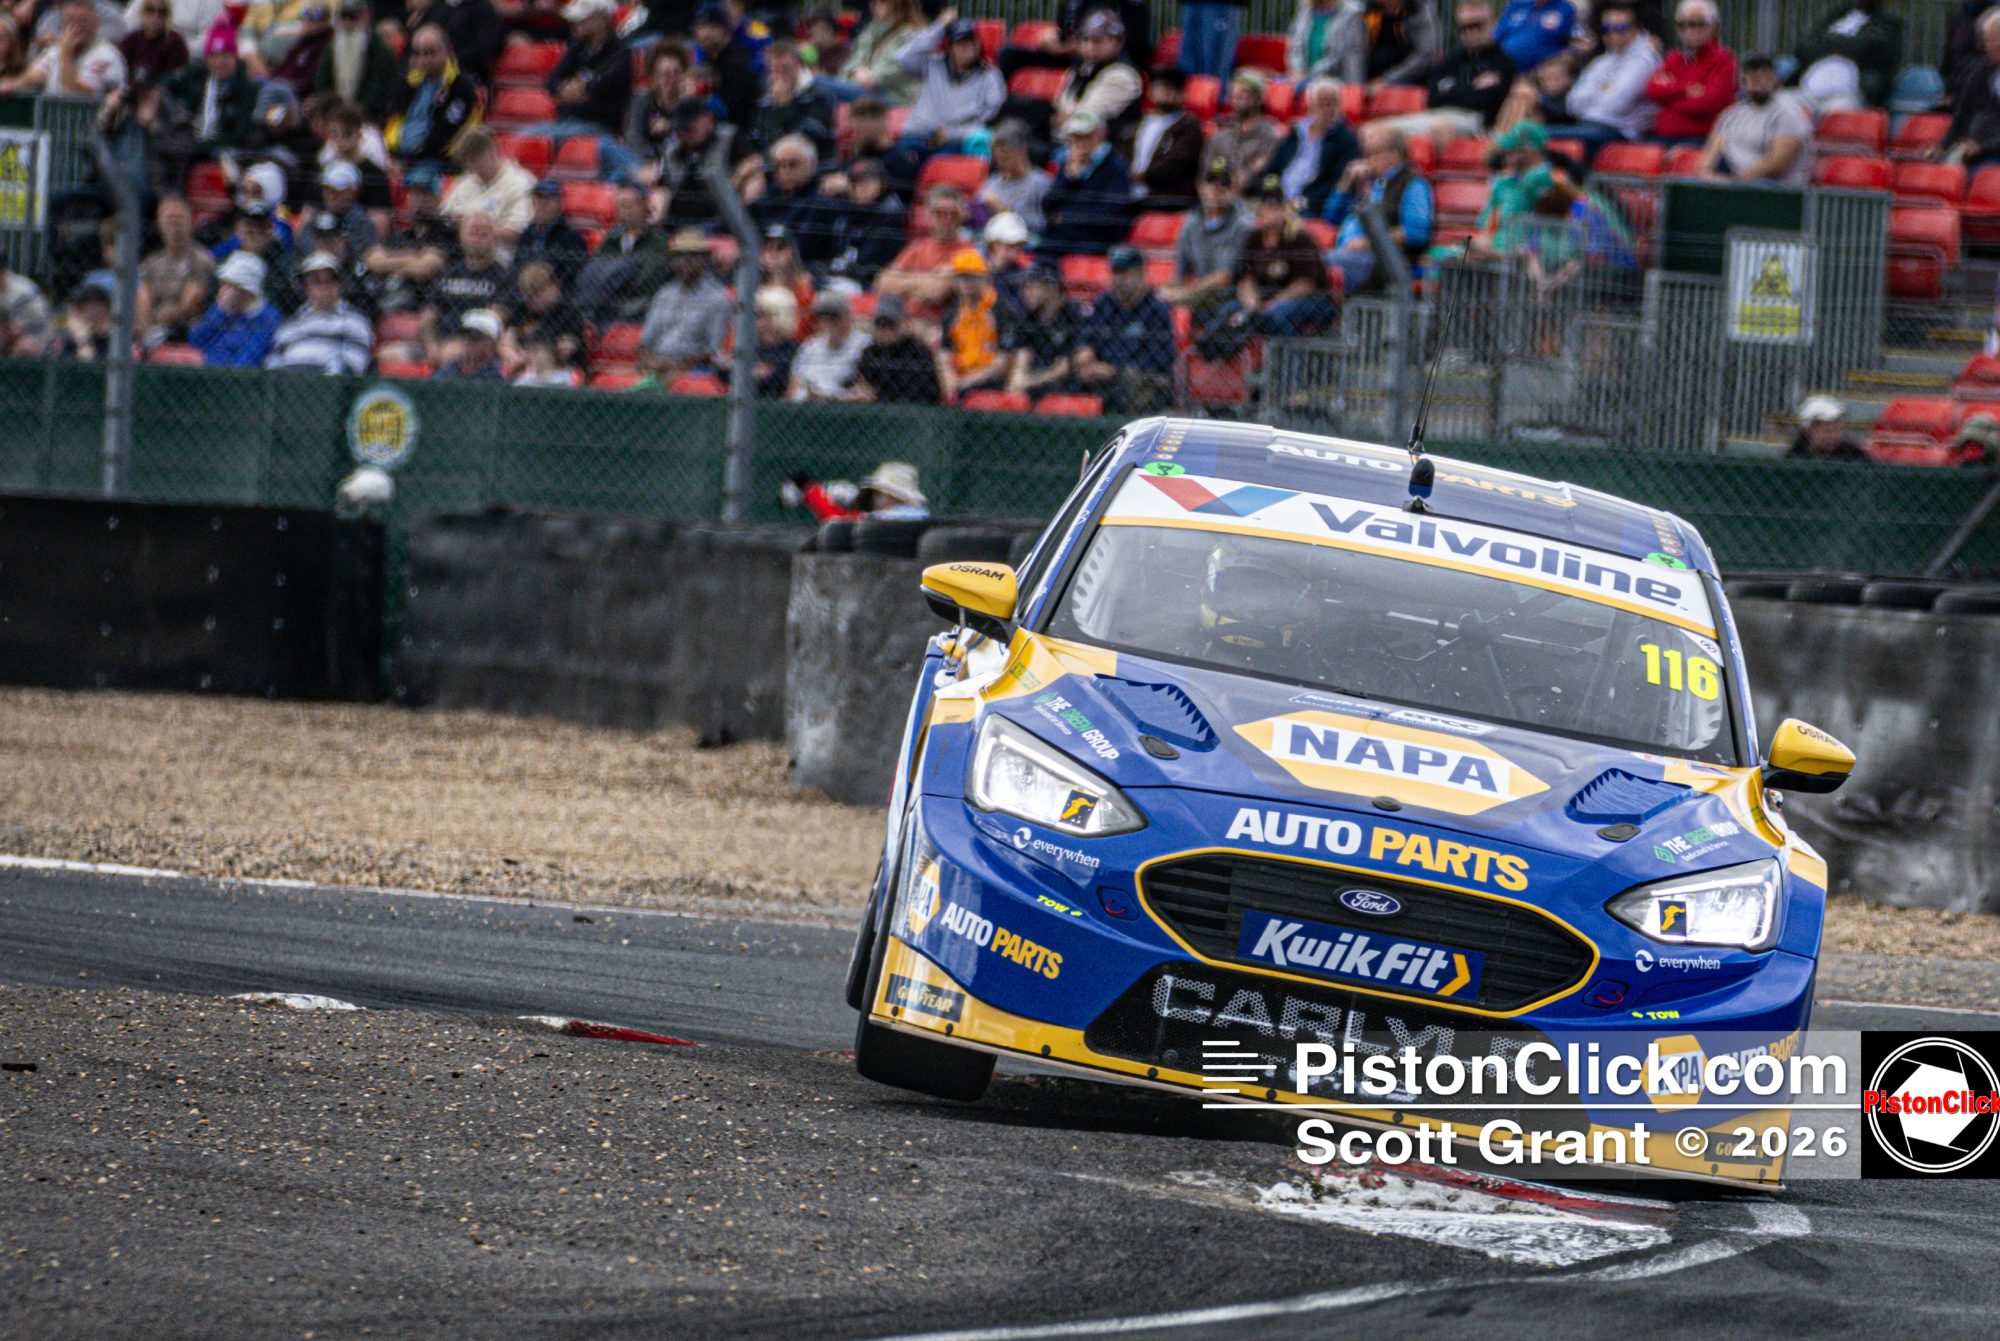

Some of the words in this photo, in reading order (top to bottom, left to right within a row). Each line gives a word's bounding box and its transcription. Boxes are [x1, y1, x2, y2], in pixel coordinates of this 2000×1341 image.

[1266, 444, 1404, 472] AUTO
[1309, 501, 1683, 607] Valvoline
[950, 564, 1006, 581] OSRAM
[1641, 643, 1719, 701] 116
[1045, 696, 1072, 713] THE
[1060, 708, 1095, 732] GREEN
[1082, 729, 1120, 760] GROUP
[1288, 724, 1498, 793] NAPA
[1033, 839, 1100, 868] everywhen
[1225, 807, 1362, 855] AUTO
[1369, 827, 1530, 891] PARTS
[1662, 835, 1692, 855] THE
[1037, 895, 1070, 912] TOW
[1350, 892, 1390, 913] Ford
[940, 902, 994, 947] AUTO
[990, 927, 1064, 979] PARTS
[1659, 955, 1721, 973] everywhen
[1646, 1010, 1680, 1020] TOW
